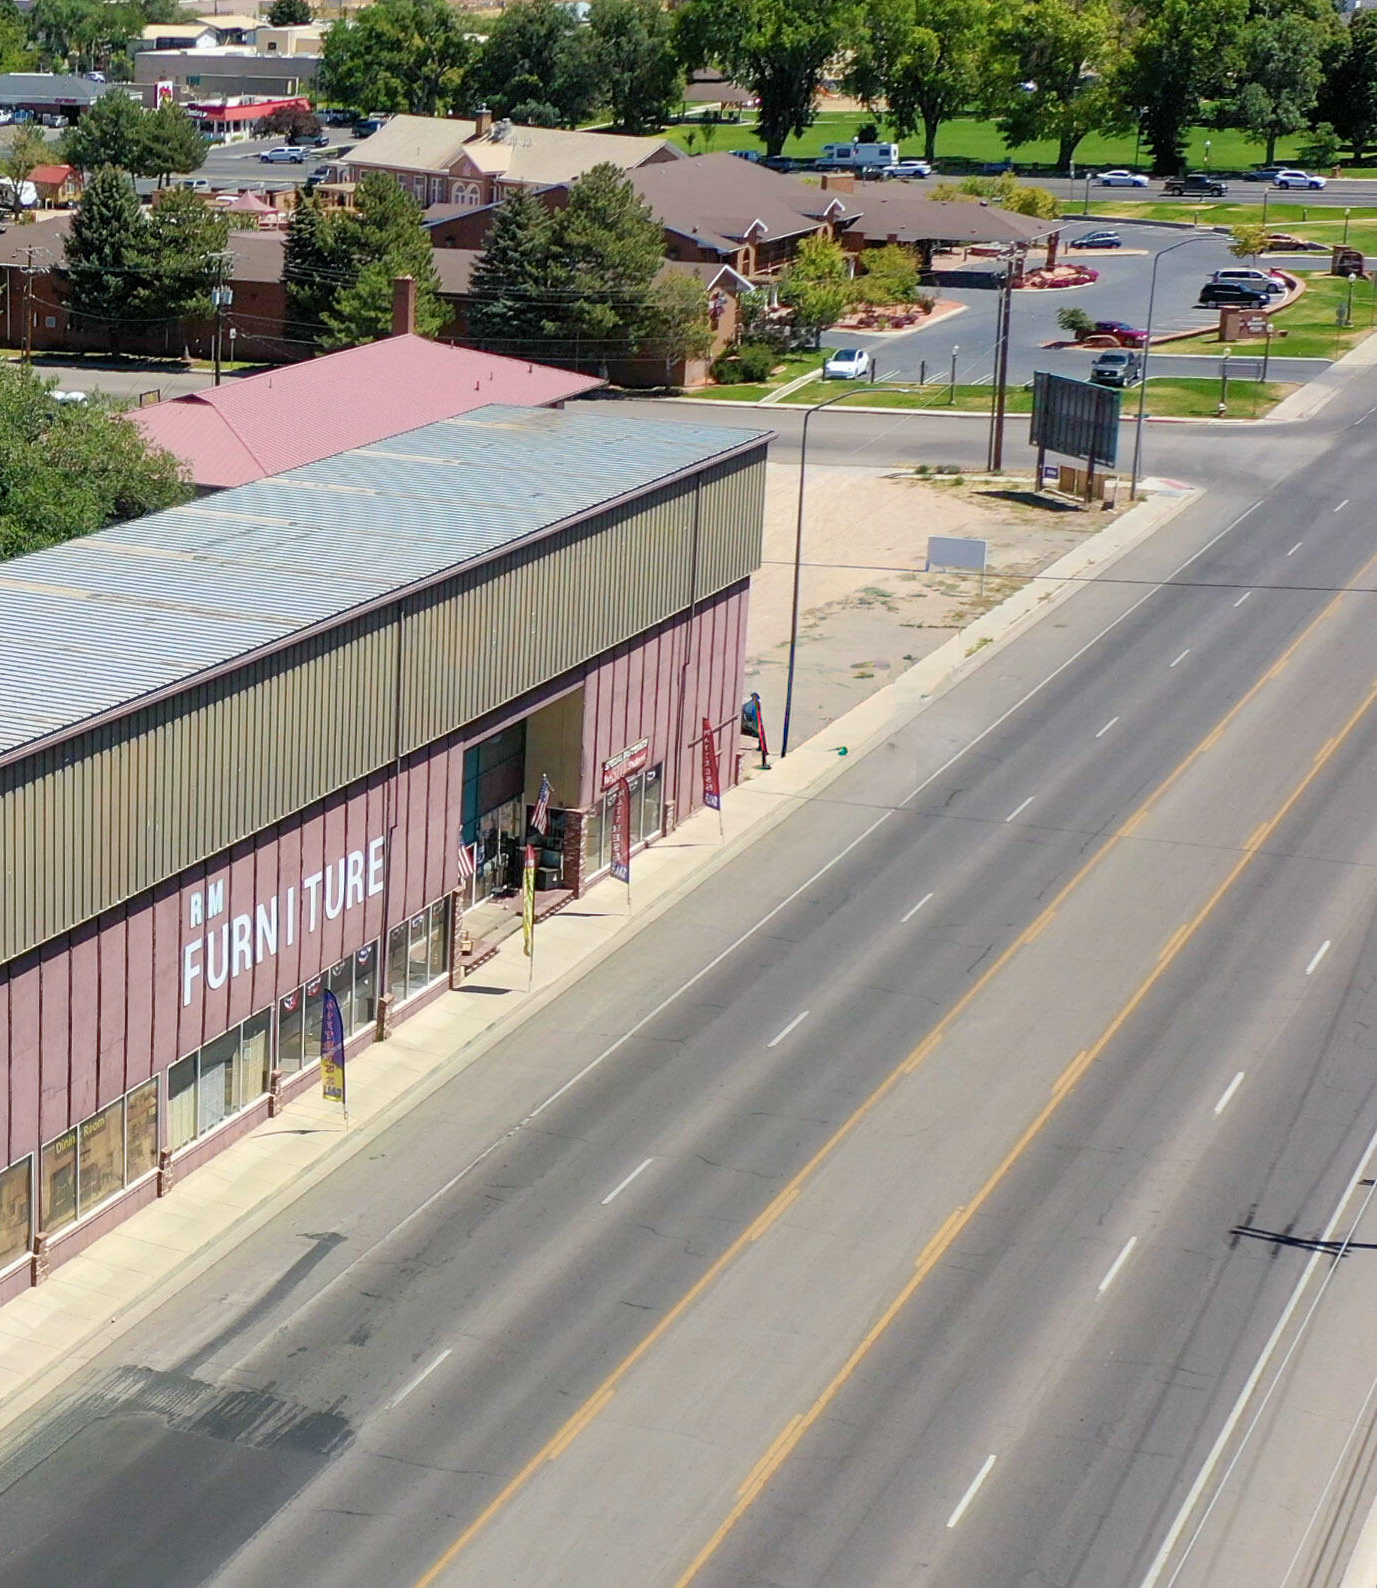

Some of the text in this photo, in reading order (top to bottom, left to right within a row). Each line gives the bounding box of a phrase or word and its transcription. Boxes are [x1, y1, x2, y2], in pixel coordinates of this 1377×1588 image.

[183, 836, 385, 1007] FURNITURE
[190, 878, 224, 929] RM
[56, 1117, 106, 1154] Dinin Room
